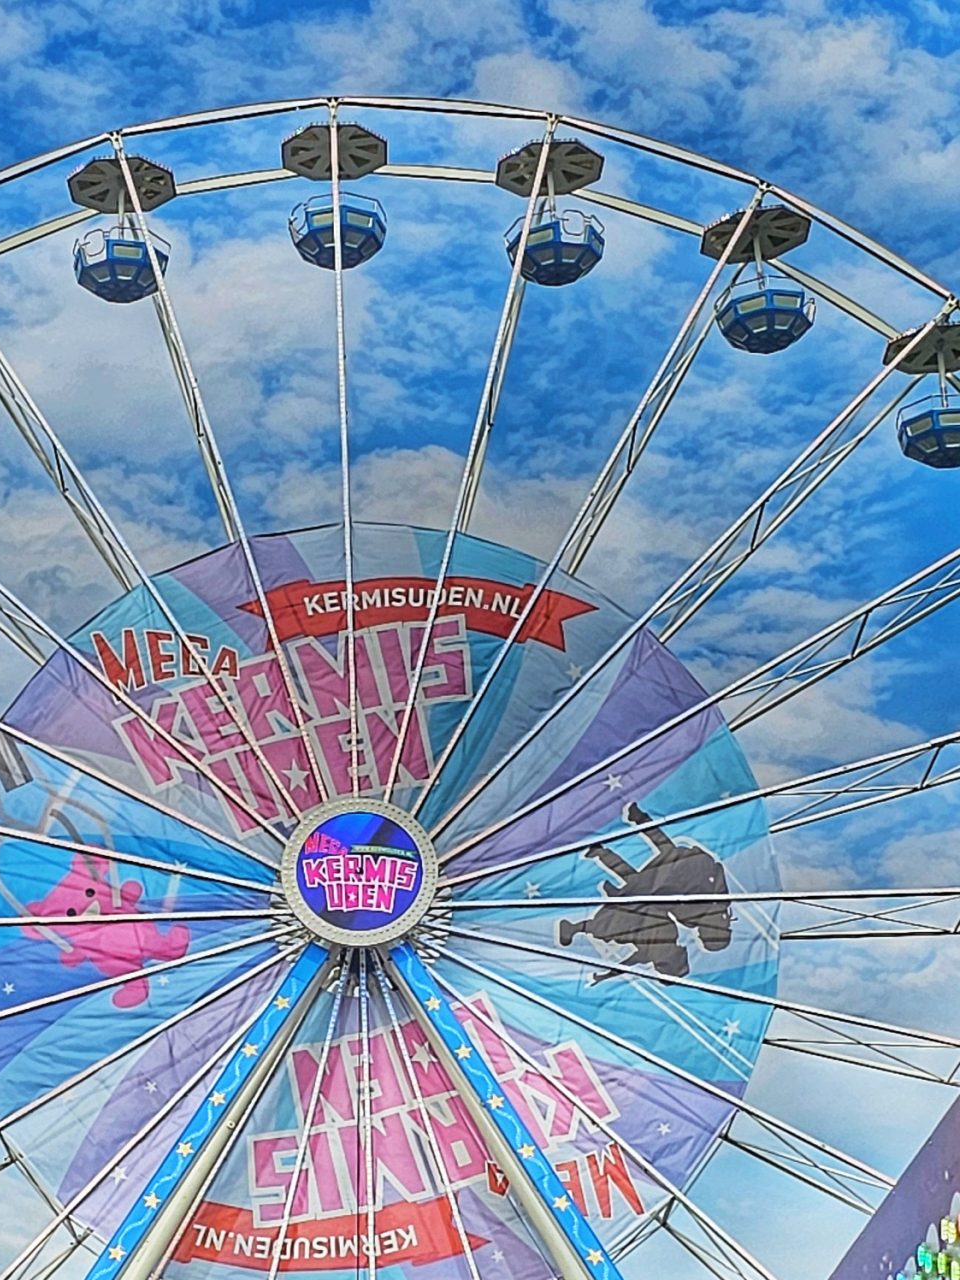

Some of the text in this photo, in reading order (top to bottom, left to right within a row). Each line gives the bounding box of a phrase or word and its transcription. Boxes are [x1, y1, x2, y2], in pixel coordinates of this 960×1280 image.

[304, 586, 525, 618] KERMISUDEN.NL
[91, 628, 240, 703] MEGA
[112, 613, 474, 794] KERMIS
[302, 854, 418, 891] KERMIS
[326, 883, 394, 913] UDEN
[193, 1224, 418, 1260] KERMISUDEN.NL
